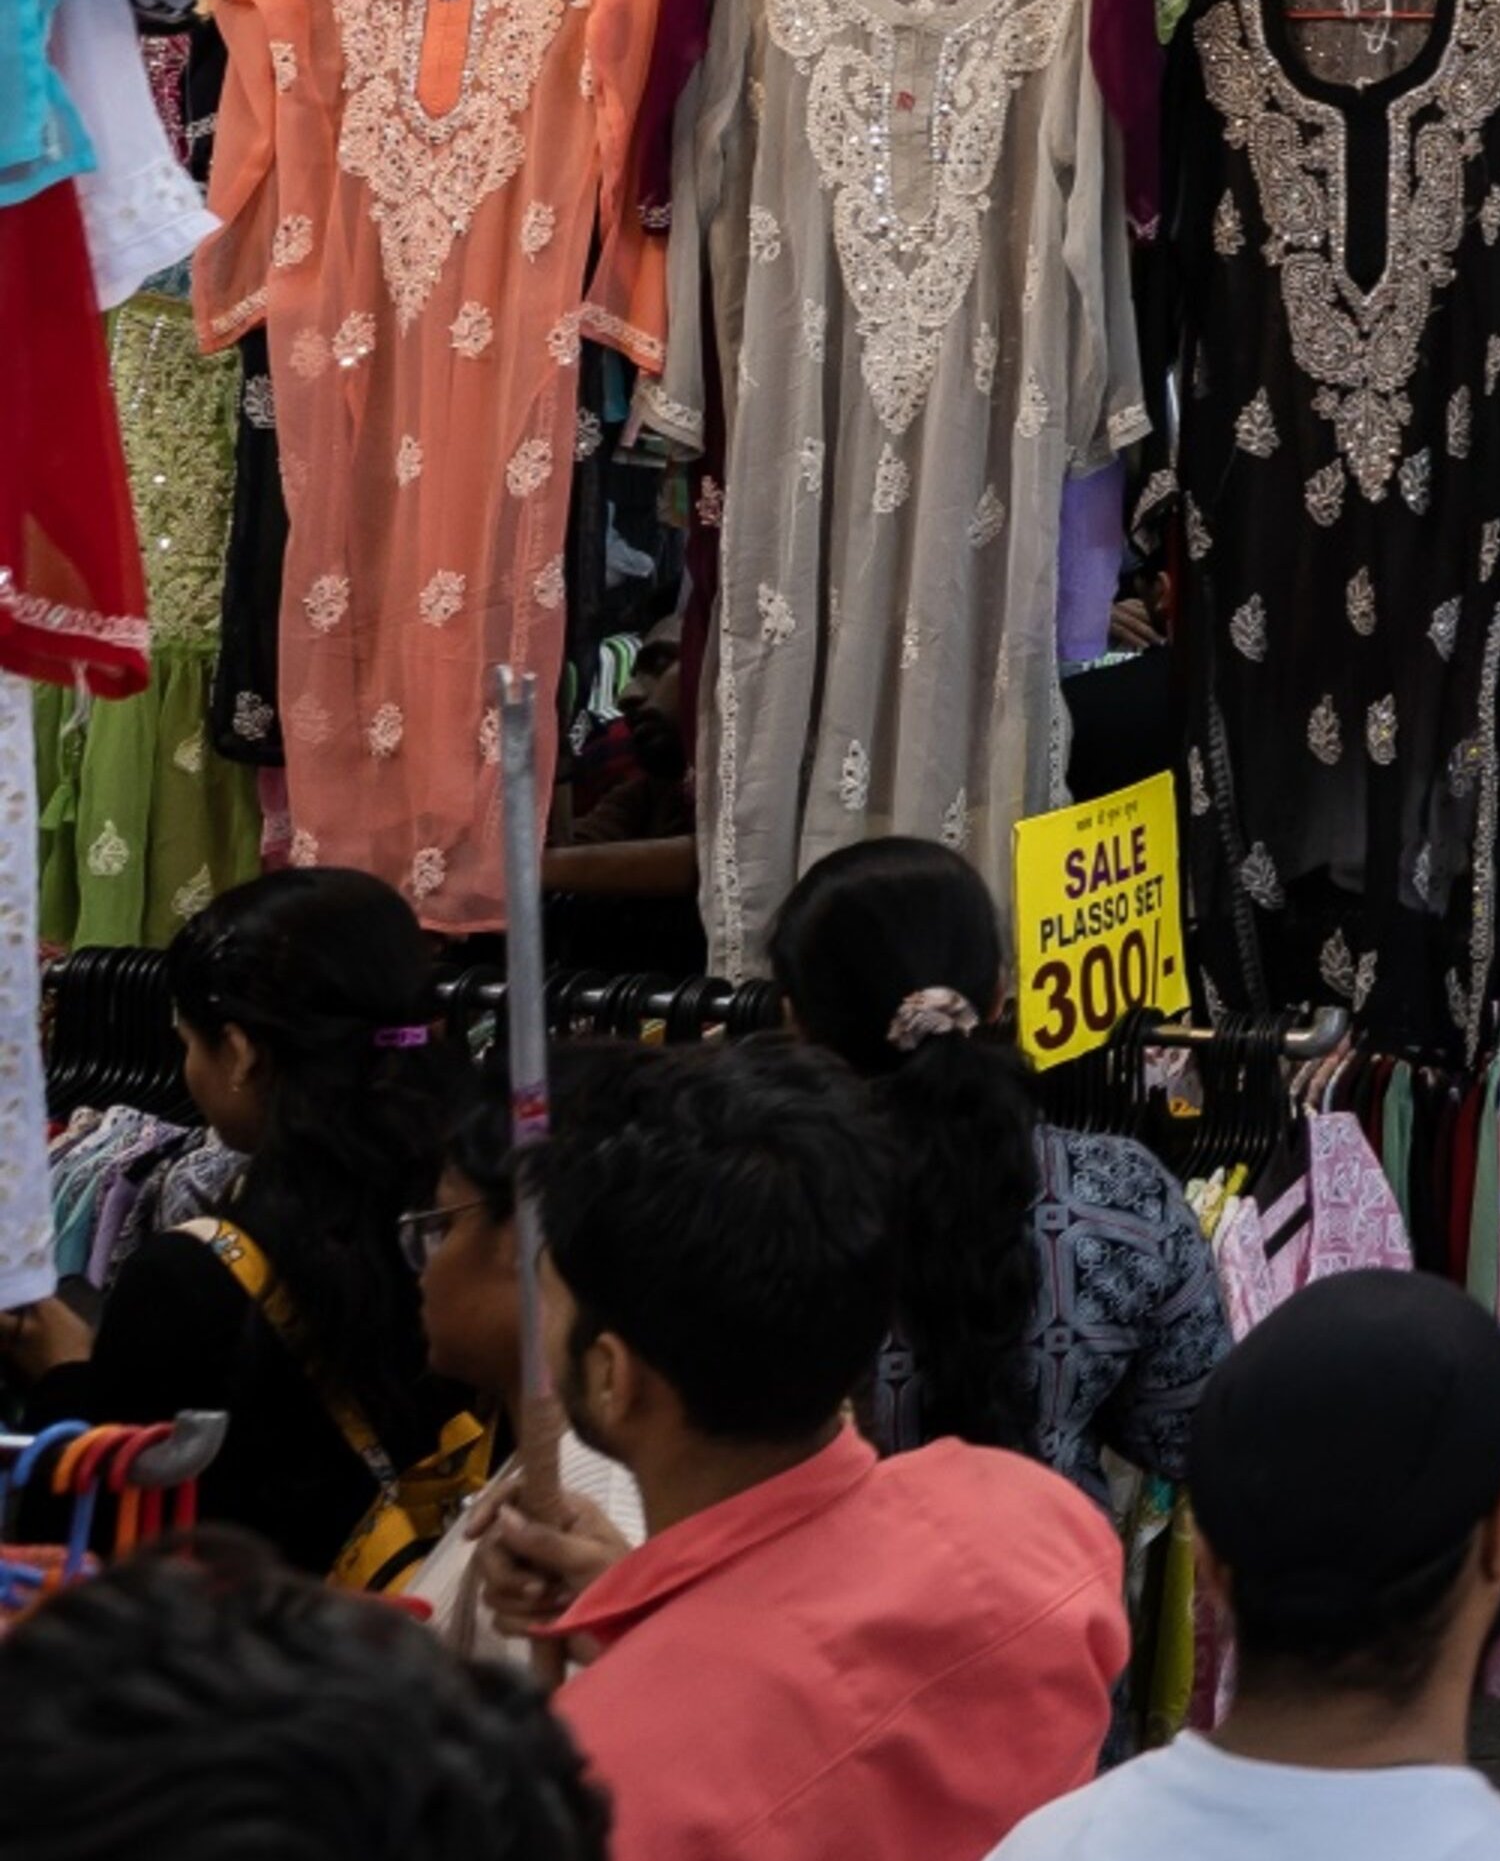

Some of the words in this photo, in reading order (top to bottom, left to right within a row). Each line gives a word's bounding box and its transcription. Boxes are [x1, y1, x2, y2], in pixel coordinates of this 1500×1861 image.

[1064, 823, 1147, 900] SALE
[1040, 891, 1129, 954] PLASSO
[1134, 874, 1164, 919] SET
[1031, 917, 1175, 1051] 300/-
